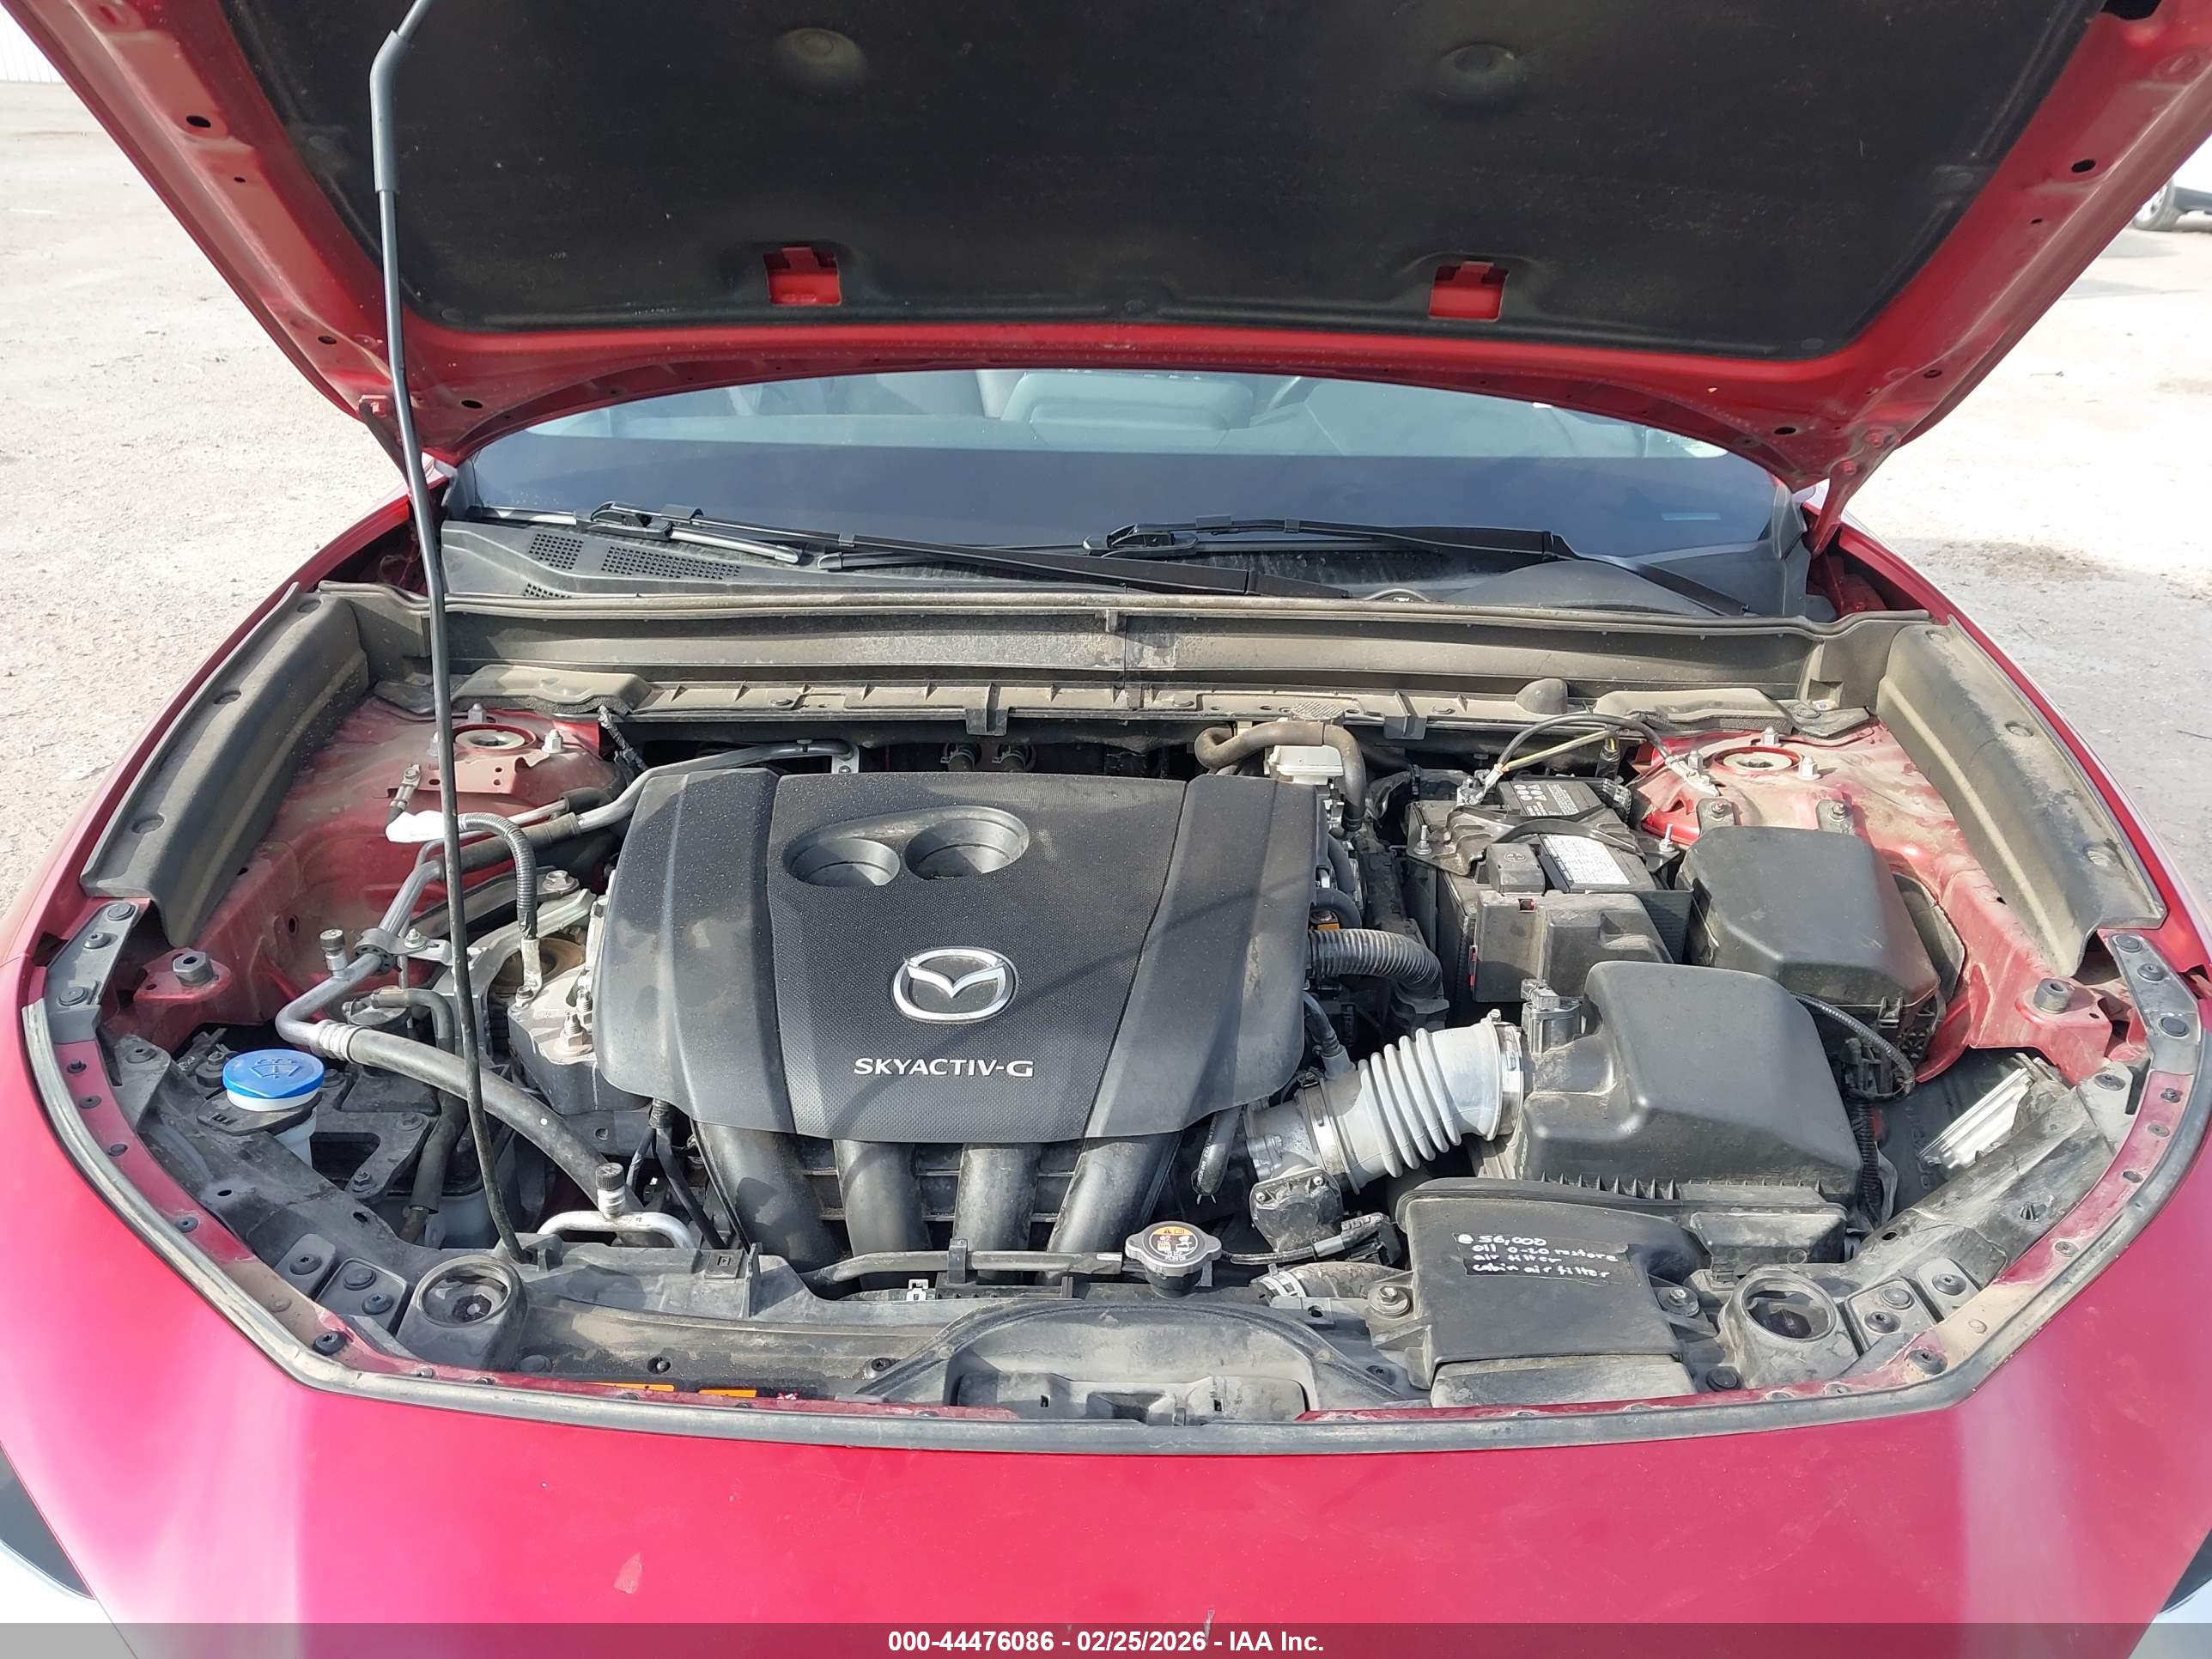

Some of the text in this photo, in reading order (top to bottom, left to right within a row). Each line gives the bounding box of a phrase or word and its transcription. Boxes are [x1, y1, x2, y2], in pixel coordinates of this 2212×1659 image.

[854, 1057, 1034, 1078] SKYACTIV-G
[1478, 1235, 1547, 1246] 56,000
[1472, 1262, 1611, 1278] cabin air filter
